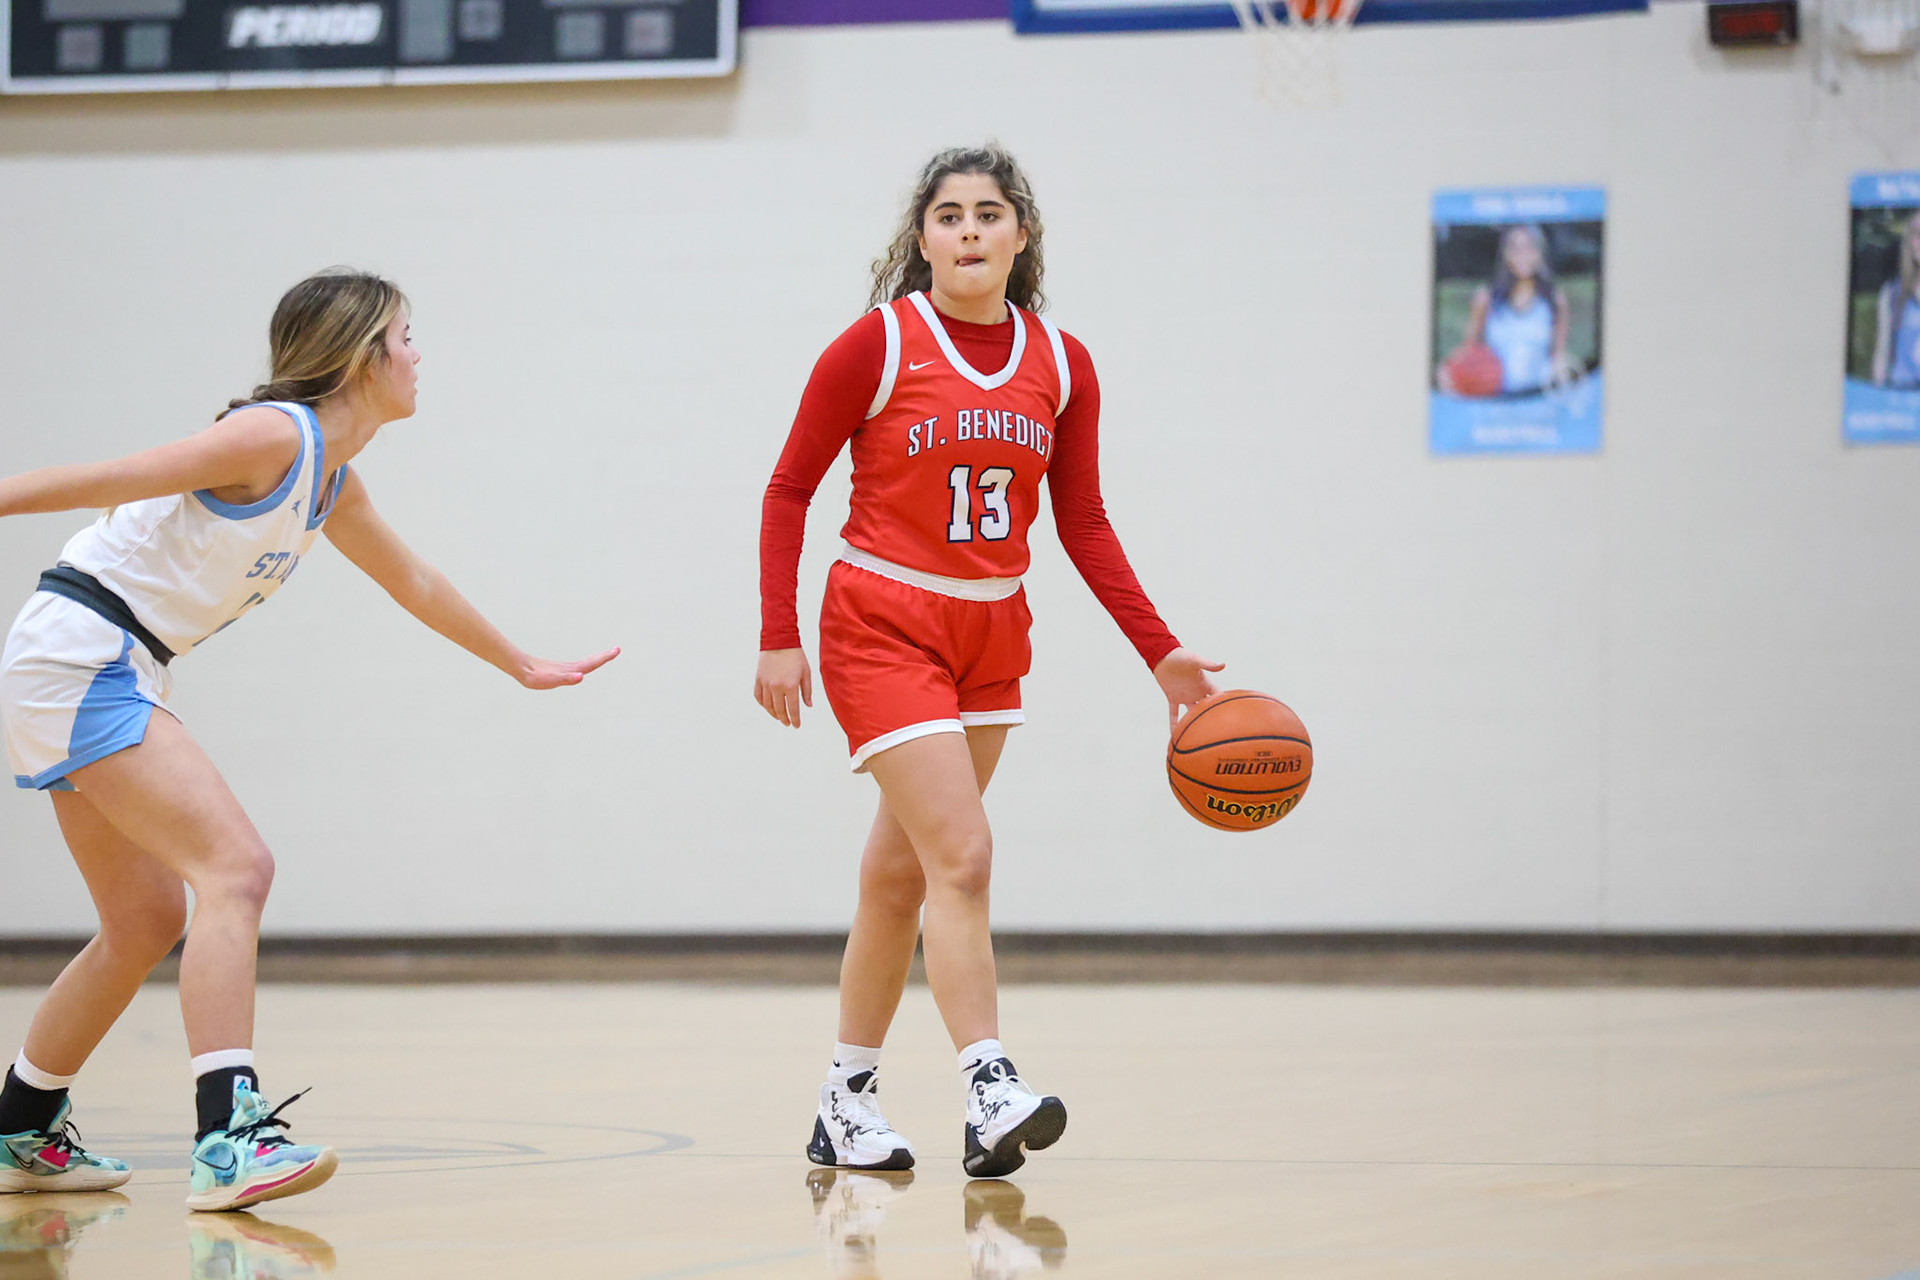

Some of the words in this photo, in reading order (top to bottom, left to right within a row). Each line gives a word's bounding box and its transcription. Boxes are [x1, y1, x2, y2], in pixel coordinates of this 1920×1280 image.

[227, 3, 383, 48] PERIOD
[906, 416, 947, 457] ST.
[956, 408, 1053, 463] BENEDICT
[946, 464, 1016, 543] 13
[1215, 759, 1302, 775] EVOLUTION
[1206, 793, 1300, 823] Wilson
